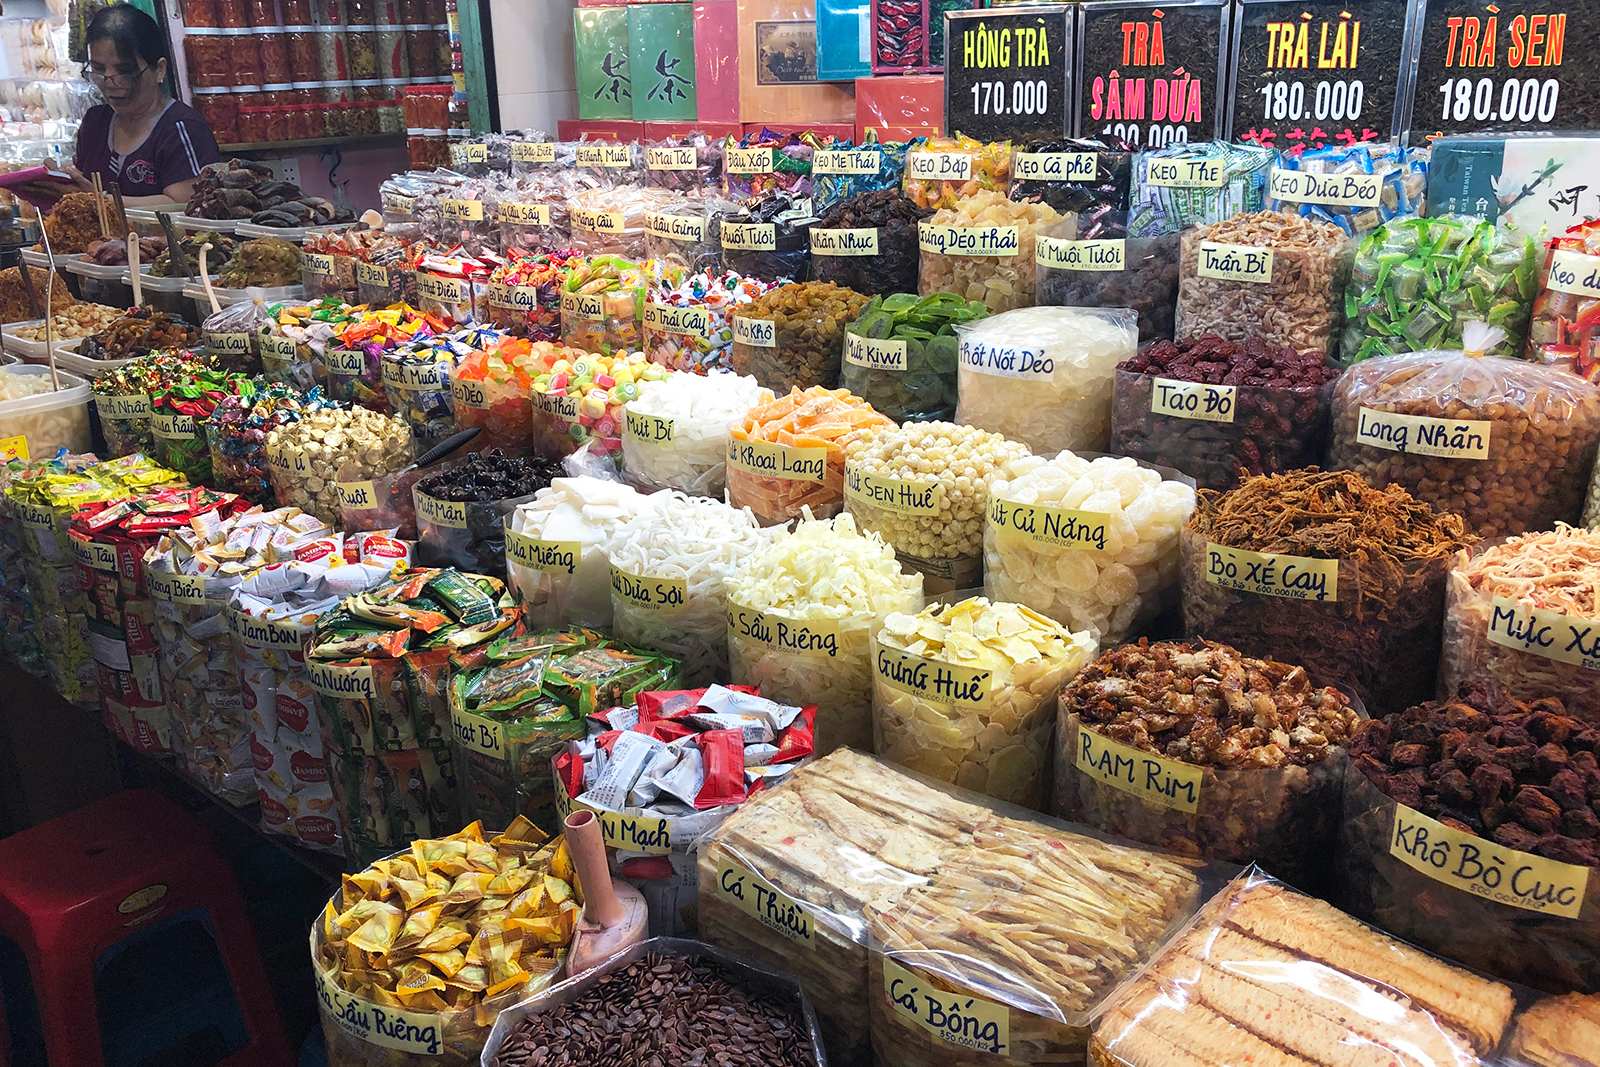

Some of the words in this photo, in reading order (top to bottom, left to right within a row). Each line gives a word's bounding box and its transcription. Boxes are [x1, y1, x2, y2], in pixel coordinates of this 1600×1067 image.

[1015, 17, 1050, 67] TRÀ
[1121, 9, 1165, 67] TRÀ
[1266, 11, 1313, 69] TRÀ
[1318, 11, 1361, 70] LÀI
[1446, 4, 1501, 67] TRÀ
[1508, 13, 1568, 68] SEN
[971, 80, 1048, 115] 170.000
[1091, 69, 1146, 120] SÂM
[1152, 66, 1202, 123] DỨA
[1261, 80, 1365, 121] 180.000
[1440, 78, 1560, 122] 180.000
[866, 345, 903, 365] Kiwi
[1360, 413, 1409, 451] Long
[1416, 424, 1484, 450] Nhãn
[781, 452, 824, 481] Lang
[1043, 511, 1108, 550] Năng
[1282, 564, 1329, 600] Cay
[777, 622, 839, 657] Riêng
[722, 868, 745, 901] Cá
[371, 1007, 442, 1054] Riêng
[890, 978, 919, 1015] Cá
[924, 994, 1006, 1054] Bống
